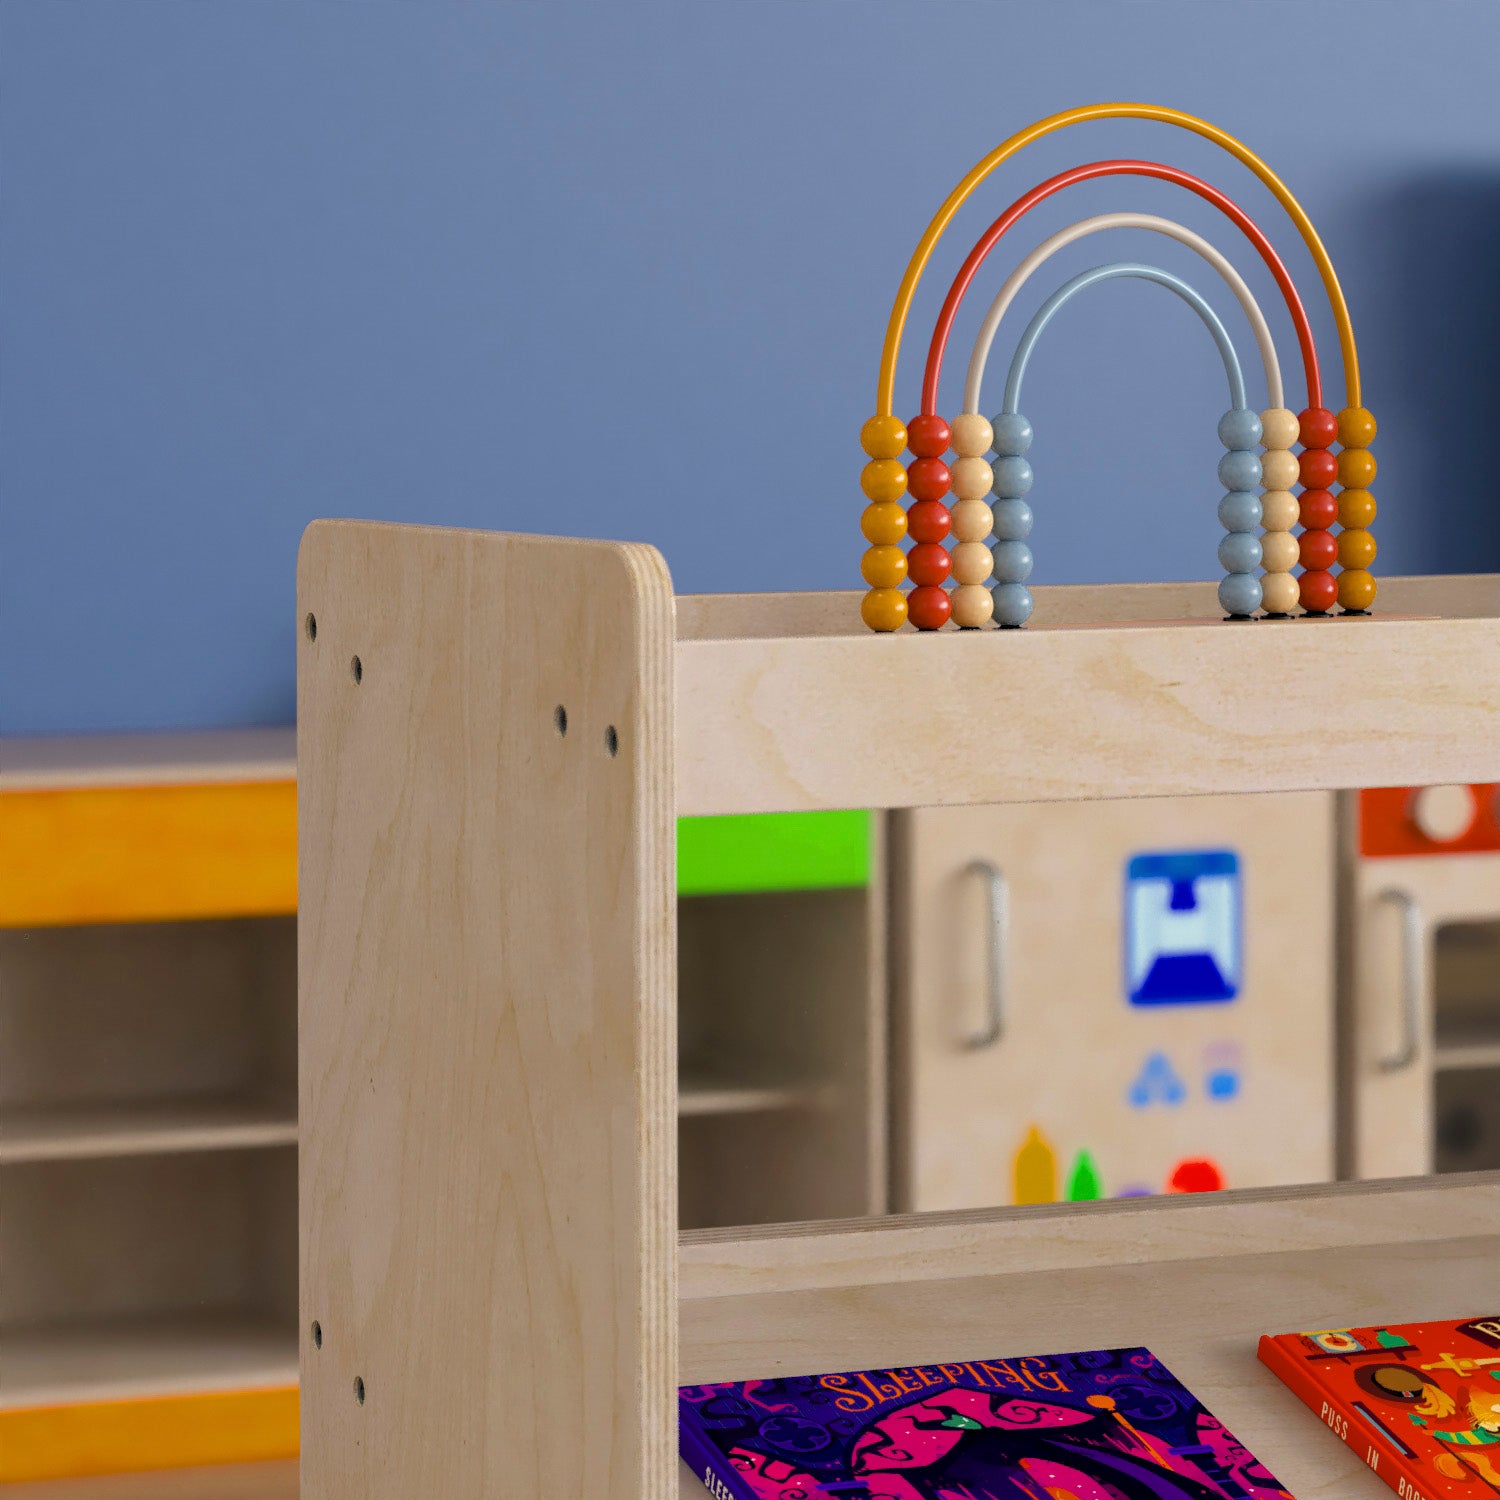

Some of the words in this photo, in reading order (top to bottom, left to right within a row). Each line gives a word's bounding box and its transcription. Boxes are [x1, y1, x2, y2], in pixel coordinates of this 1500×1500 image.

[820, 1357, 1073, 1412] SLEEPING
[1321, 1401, 1348, 1440] PUSS
[1366, 1445, 1379, 1471] IN
